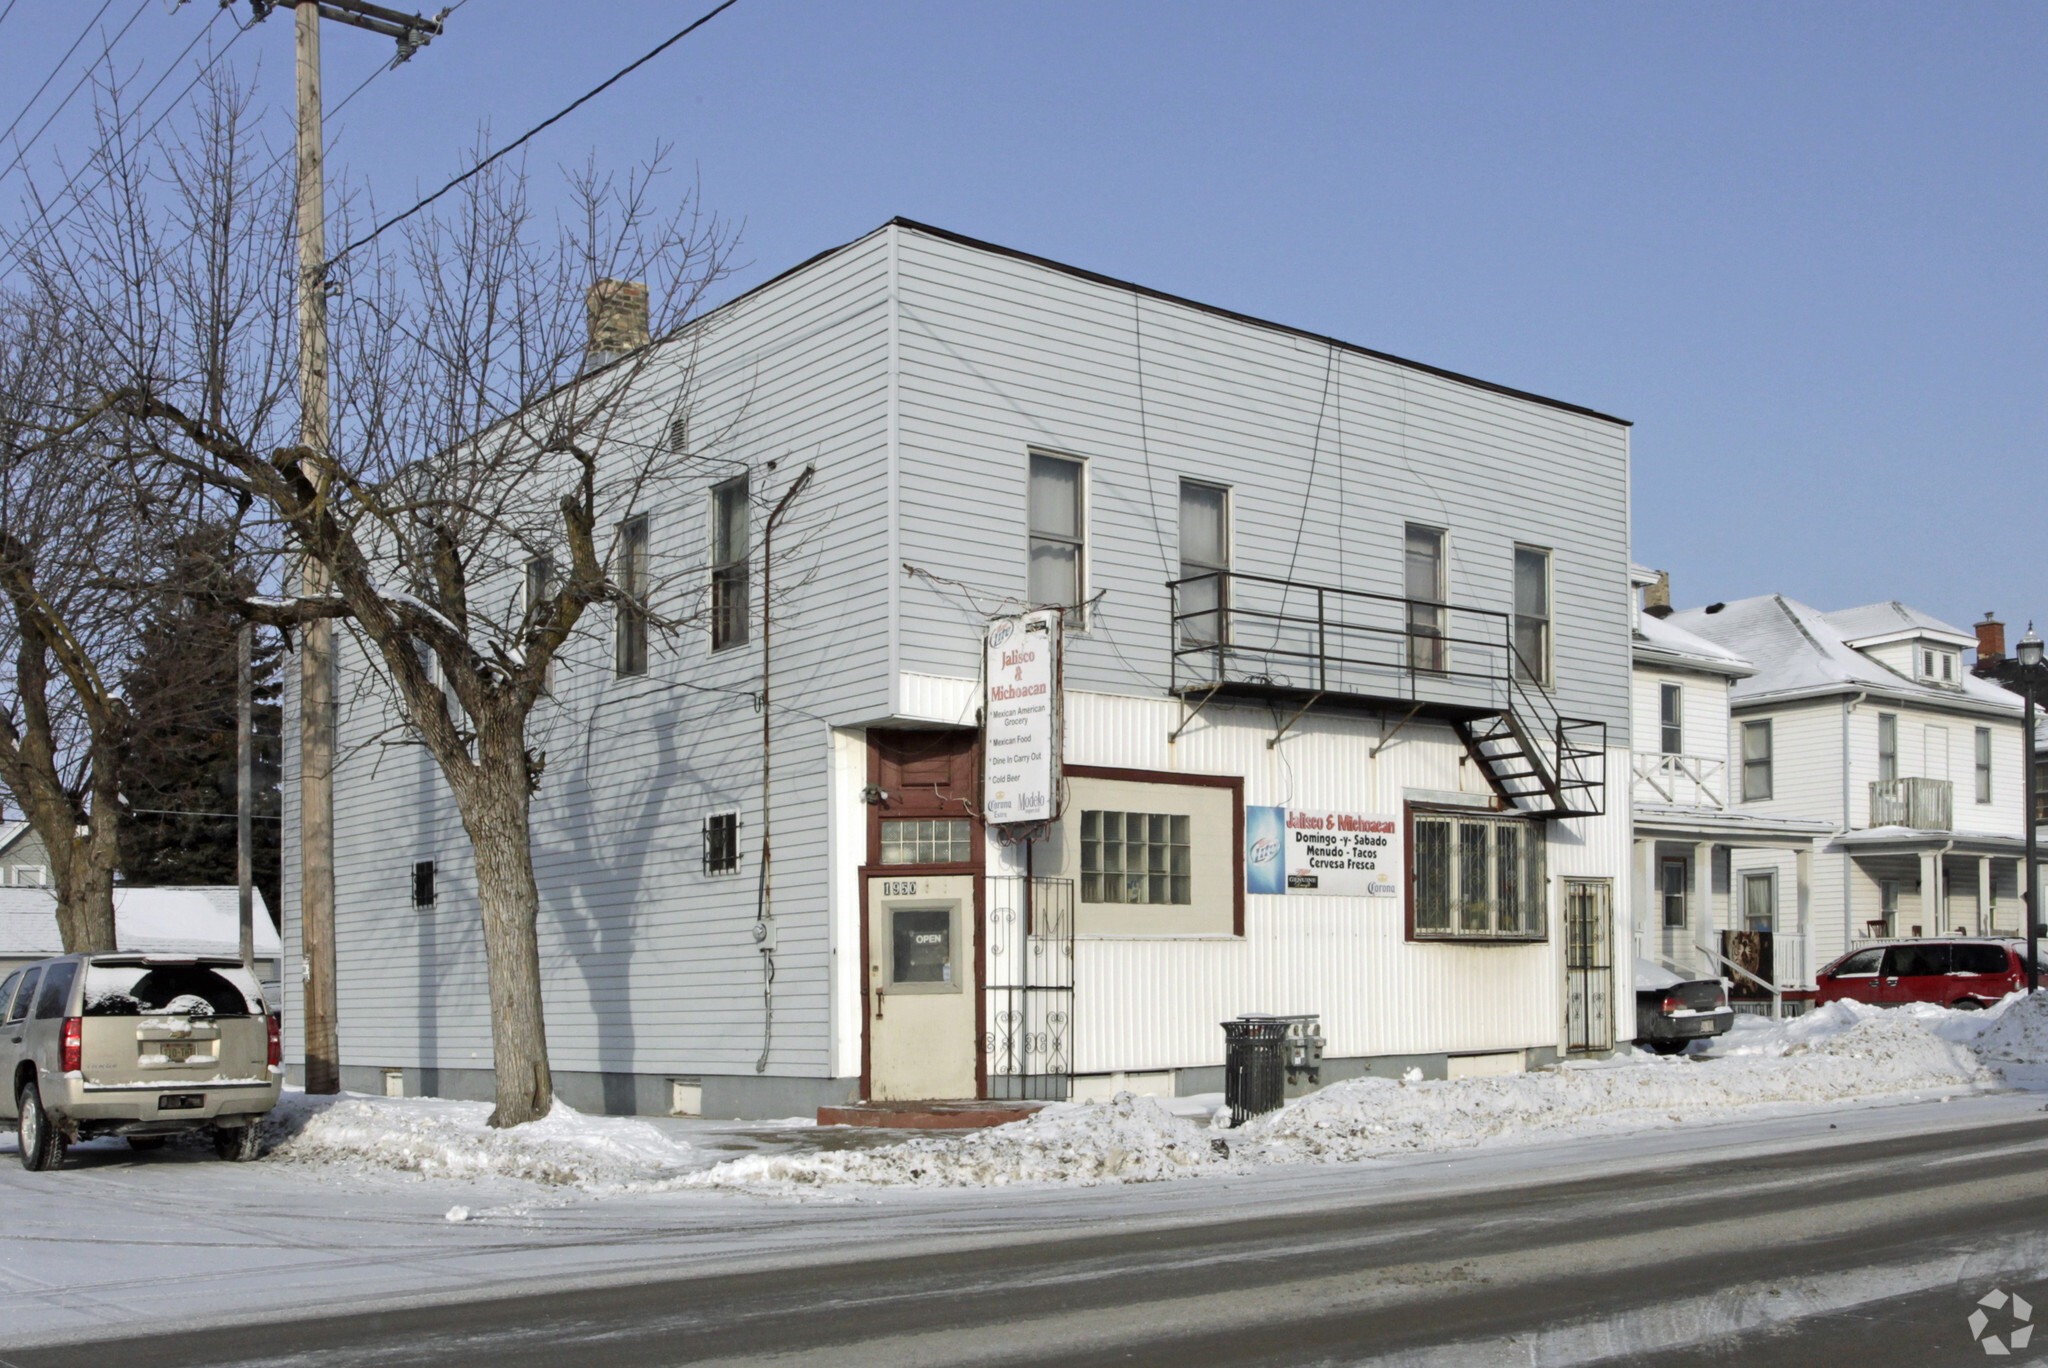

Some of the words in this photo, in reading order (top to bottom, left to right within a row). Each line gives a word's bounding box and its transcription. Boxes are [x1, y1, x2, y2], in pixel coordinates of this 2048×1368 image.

[1001, 649, 1035, 670] Jalisco
[1015, 665, 1022, 681] &
[991, 683, 1046, 702] Michoacan
[993, 708, 1016, 718] Mexican
[1017, 704, 1046, 715] American
[1004, 717, 1028, 727] Grocery
[993, 737, 1016, 747] Mexican
[1017, 734, 1032, 744] Food
[992, 757, 1006, 766] Dine
[1007, 756, 1012, 764] In
[1013, 754, 1030, 764] Carry
[1031, 752, 1042, 761] Out
[992, 775, 1006, 784] Cold
[1006, 774, 1021, 783] Beer
[987, 799, 1012, 812] Corona
[1018, 791, 1045, 811] Modelo
[1286, 811, 1324, 830] Jalisco
[1326, 814, 1336, 830] &
[1337, 814, 1396, 834] Michoacan
[1296, 832, 1337, 845] Domingo
[1354, 835, 1387, 847] Sabado
[1306, 845, 1344, 857] Menudo
[1352, 847, 1377, 859] Tacos
[1309, 857, 1345, 869] Cervesa
[1347, 859, 1375, 870] Fresca
[884, 882, 917, 895] 1950
[1367, 881, 1396, 895] Corona
[916, 934, 941, 943] OPEN
